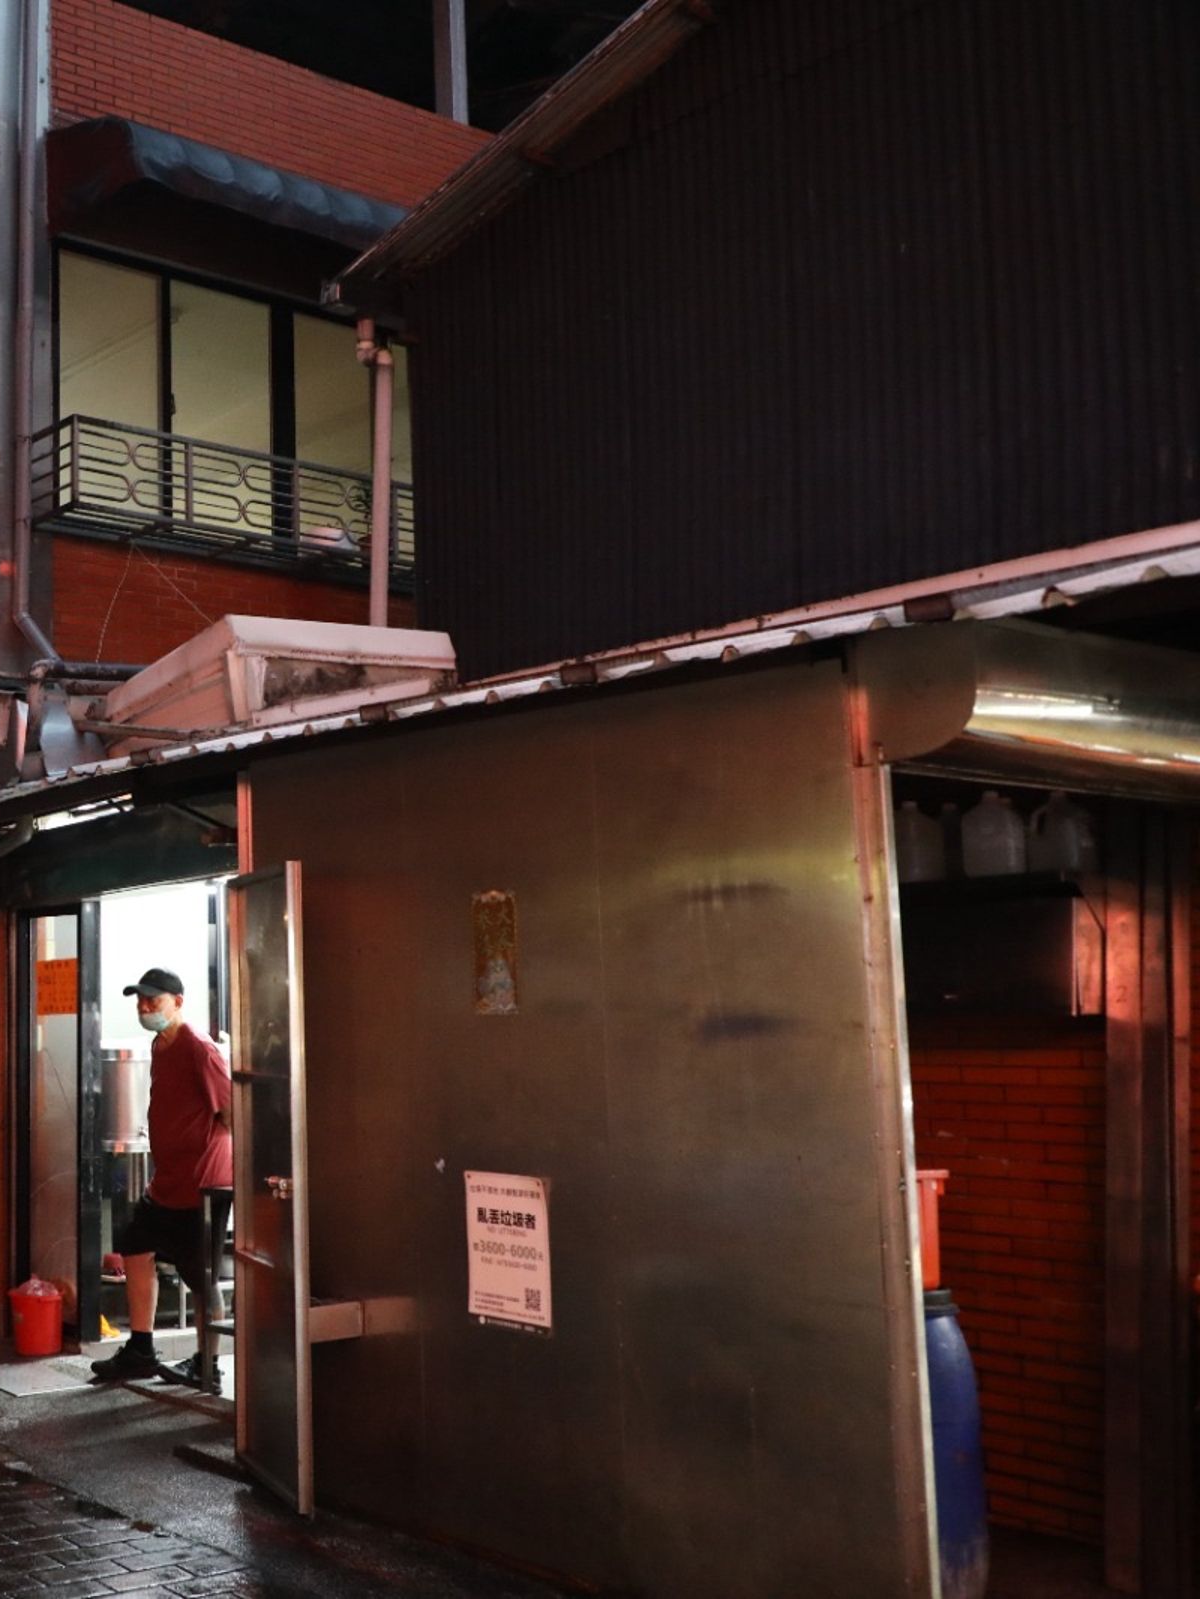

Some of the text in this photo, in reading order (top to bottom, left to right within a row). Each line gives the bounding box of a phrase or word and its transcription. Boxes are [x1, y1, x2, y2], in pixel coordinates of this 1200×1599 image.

[477, 1207, 536, 1230] 亂丟垃圾者
